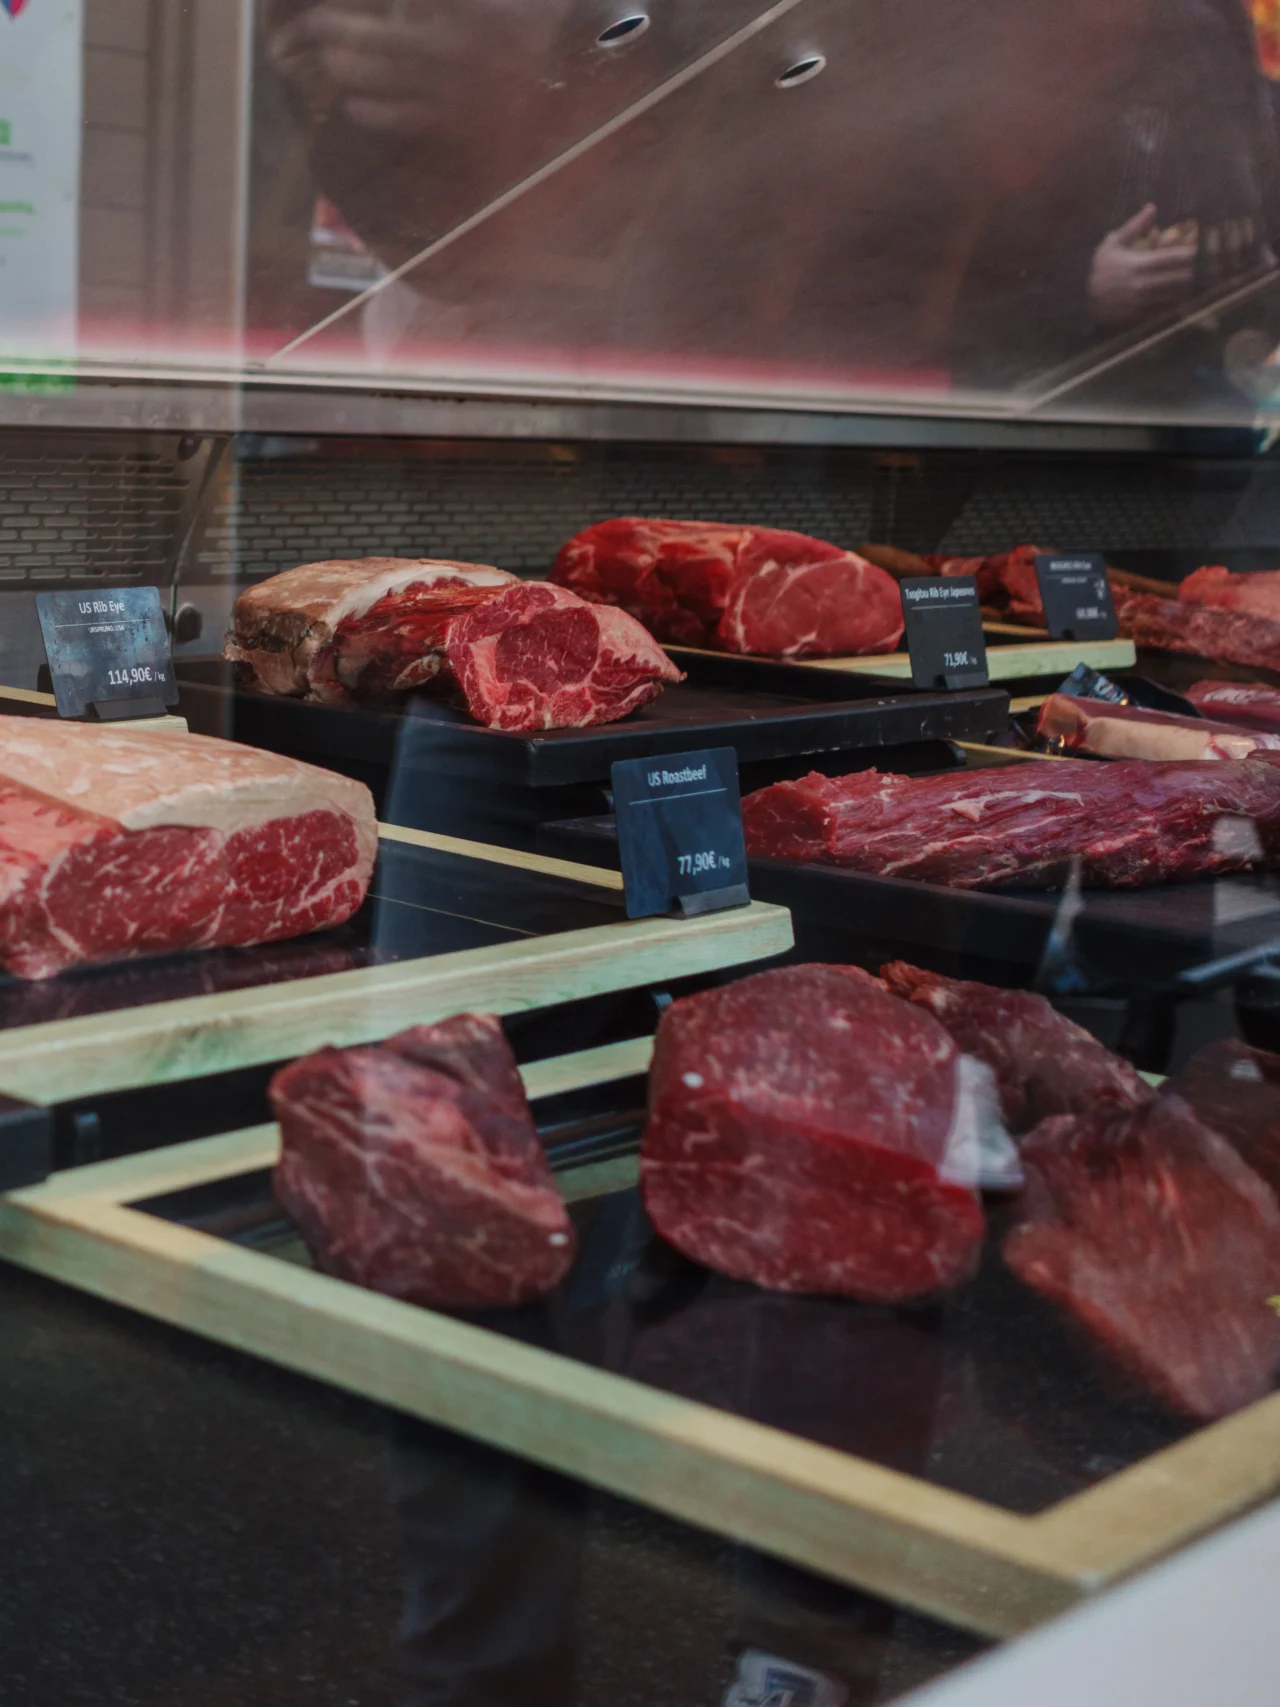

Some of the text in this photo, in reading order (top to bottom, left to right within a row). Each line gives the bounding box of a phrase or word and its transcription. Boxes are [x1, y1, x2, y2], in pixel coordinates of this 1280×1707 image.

[79, 600, 125, 614] US Rib Eye
[107, 667, 152, 685] 114,90€
[647, 764, 707, 787] US Roastbeef
[677, 850, 716, 876] 77,90€
